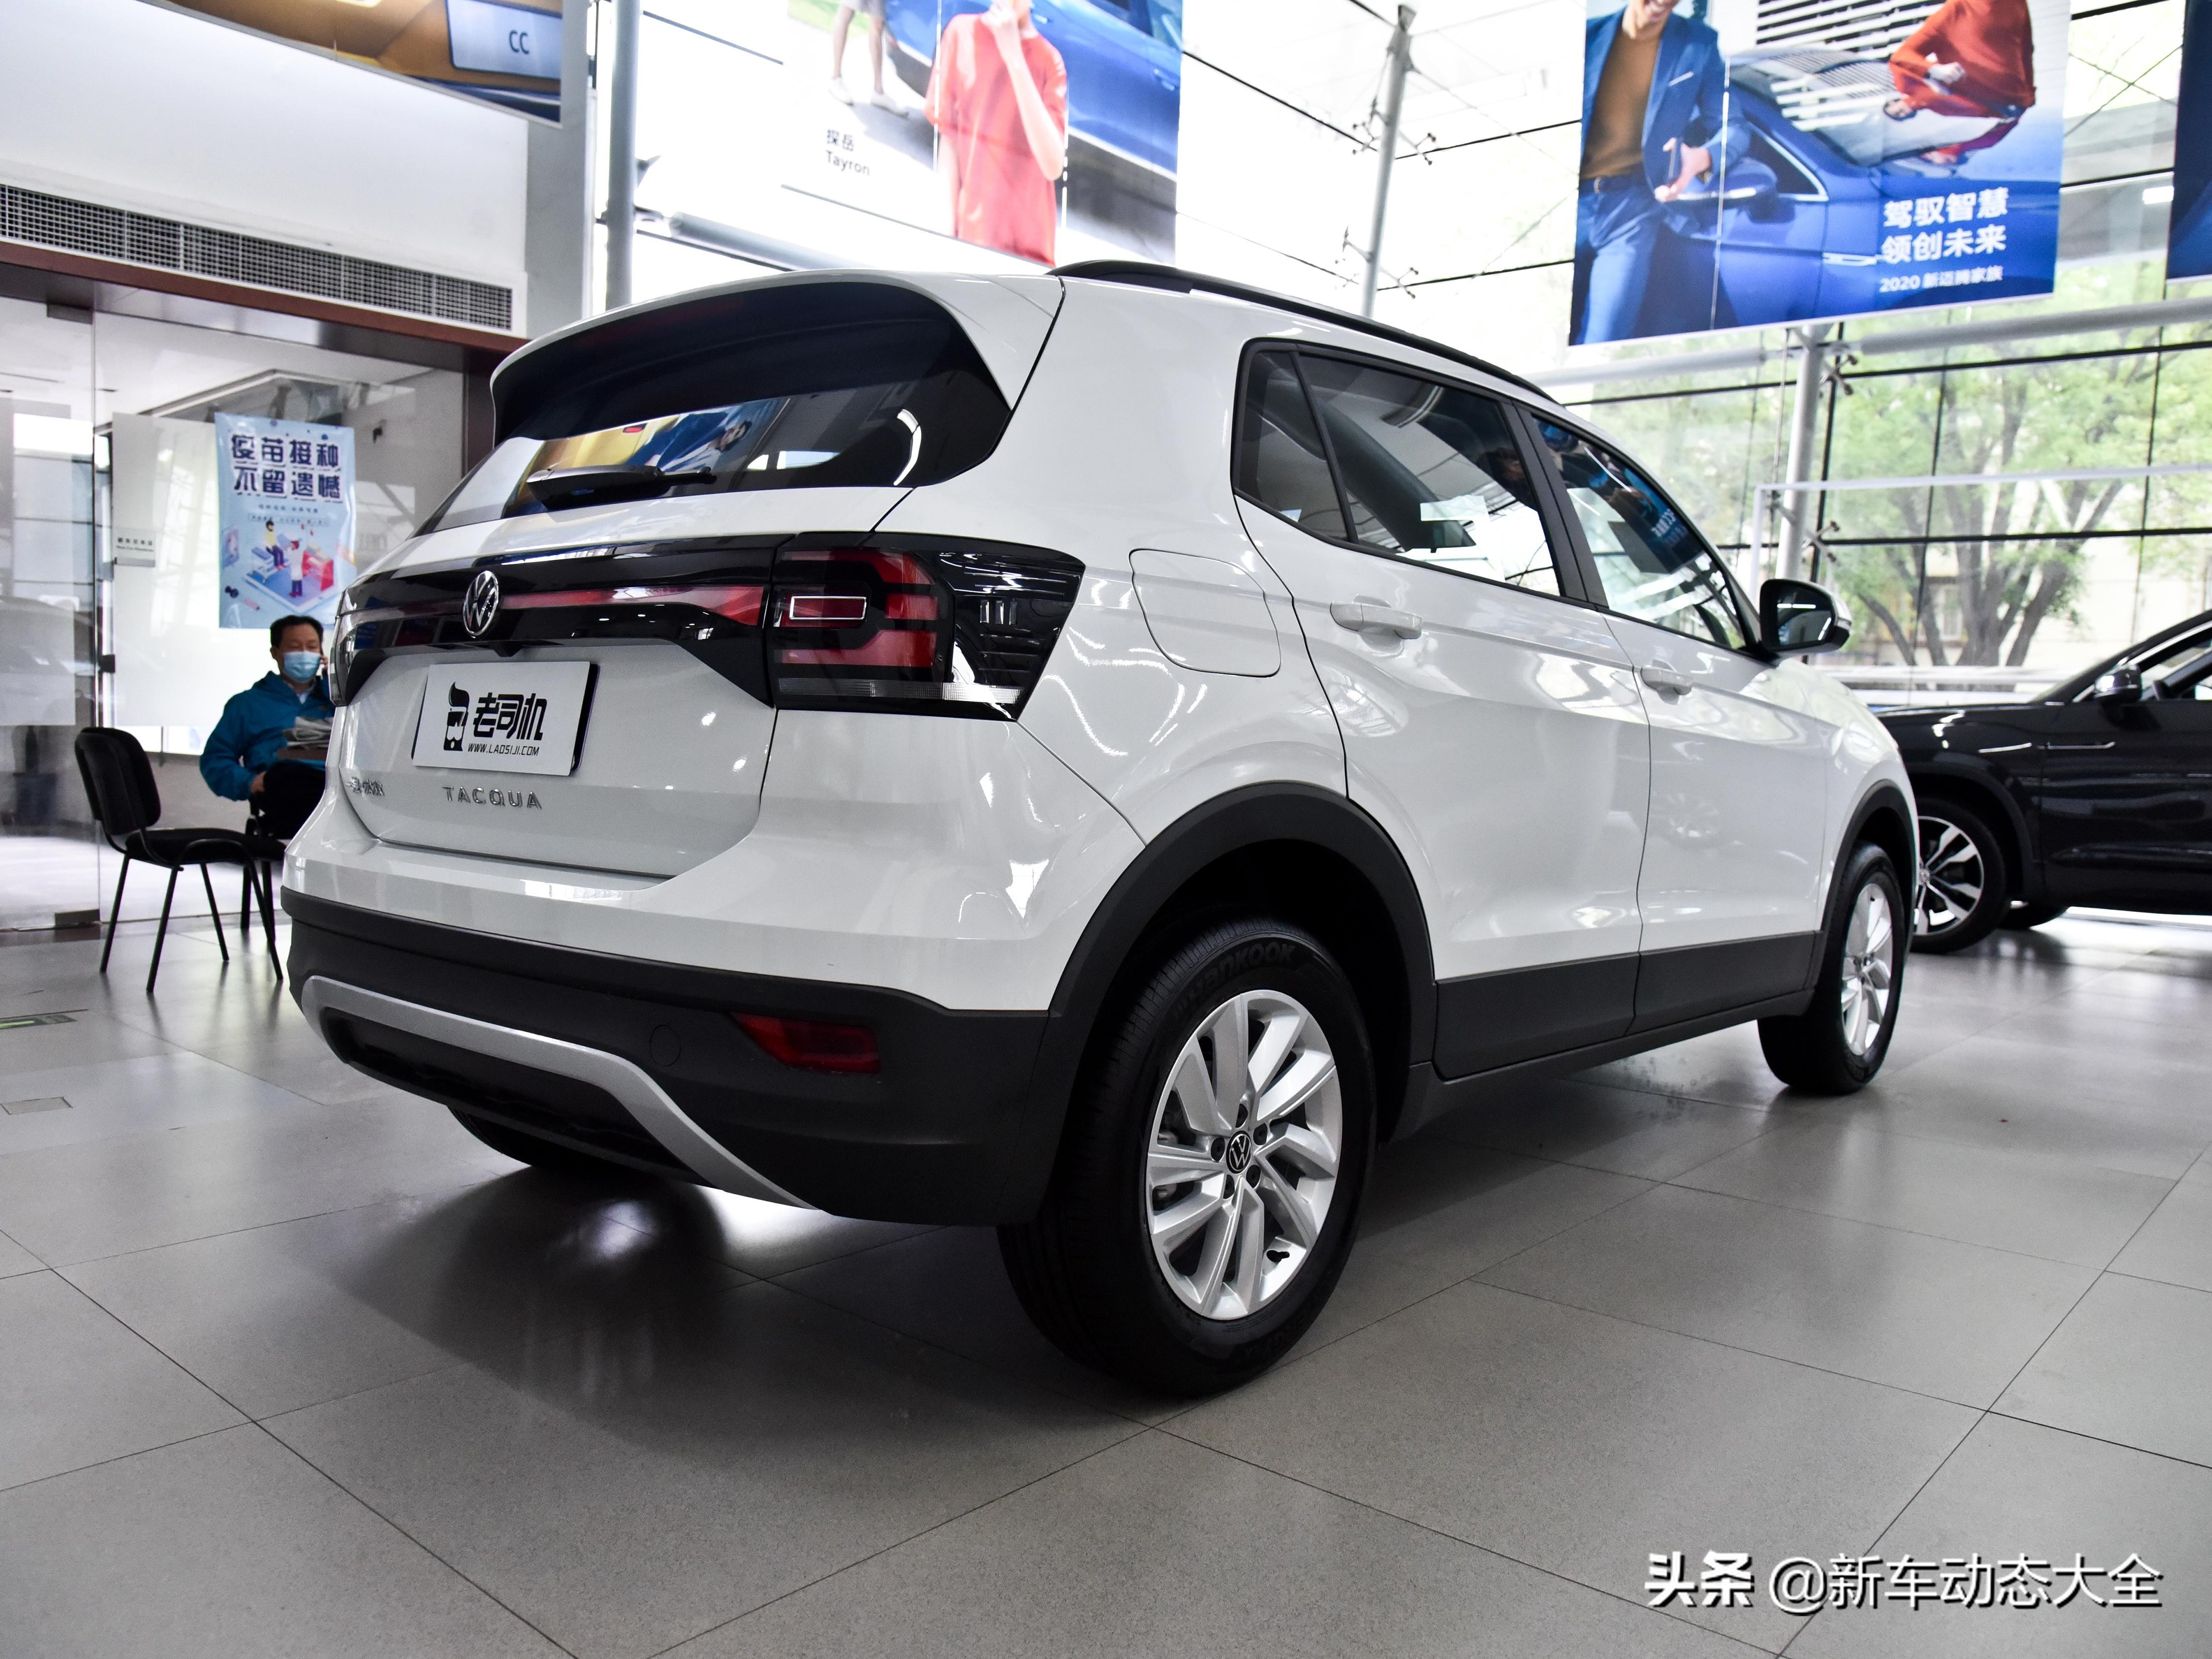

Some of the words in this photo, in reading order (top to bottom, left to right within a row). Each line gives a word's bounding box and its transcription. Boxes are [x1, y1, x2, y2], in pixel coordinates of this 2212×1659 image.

[509, 30, 530, 55] CC
[826, 150, 870, 175] Tayron
[1883, 187, 2009, 229] 驾驭智慧
[1881, 224, 2007, 264] 领创未来
[1879, 274, 1921, 293] 2020
[231, 434, 339, 468] 疫苗接种
[234, 465, 340, 499] 不留遗憾
[473, 692, 547, 741] 老司机
[467, 743, 540, 757] WWW.LAOSIJI.COM
[442, 785, 542, 810] TACQUA
